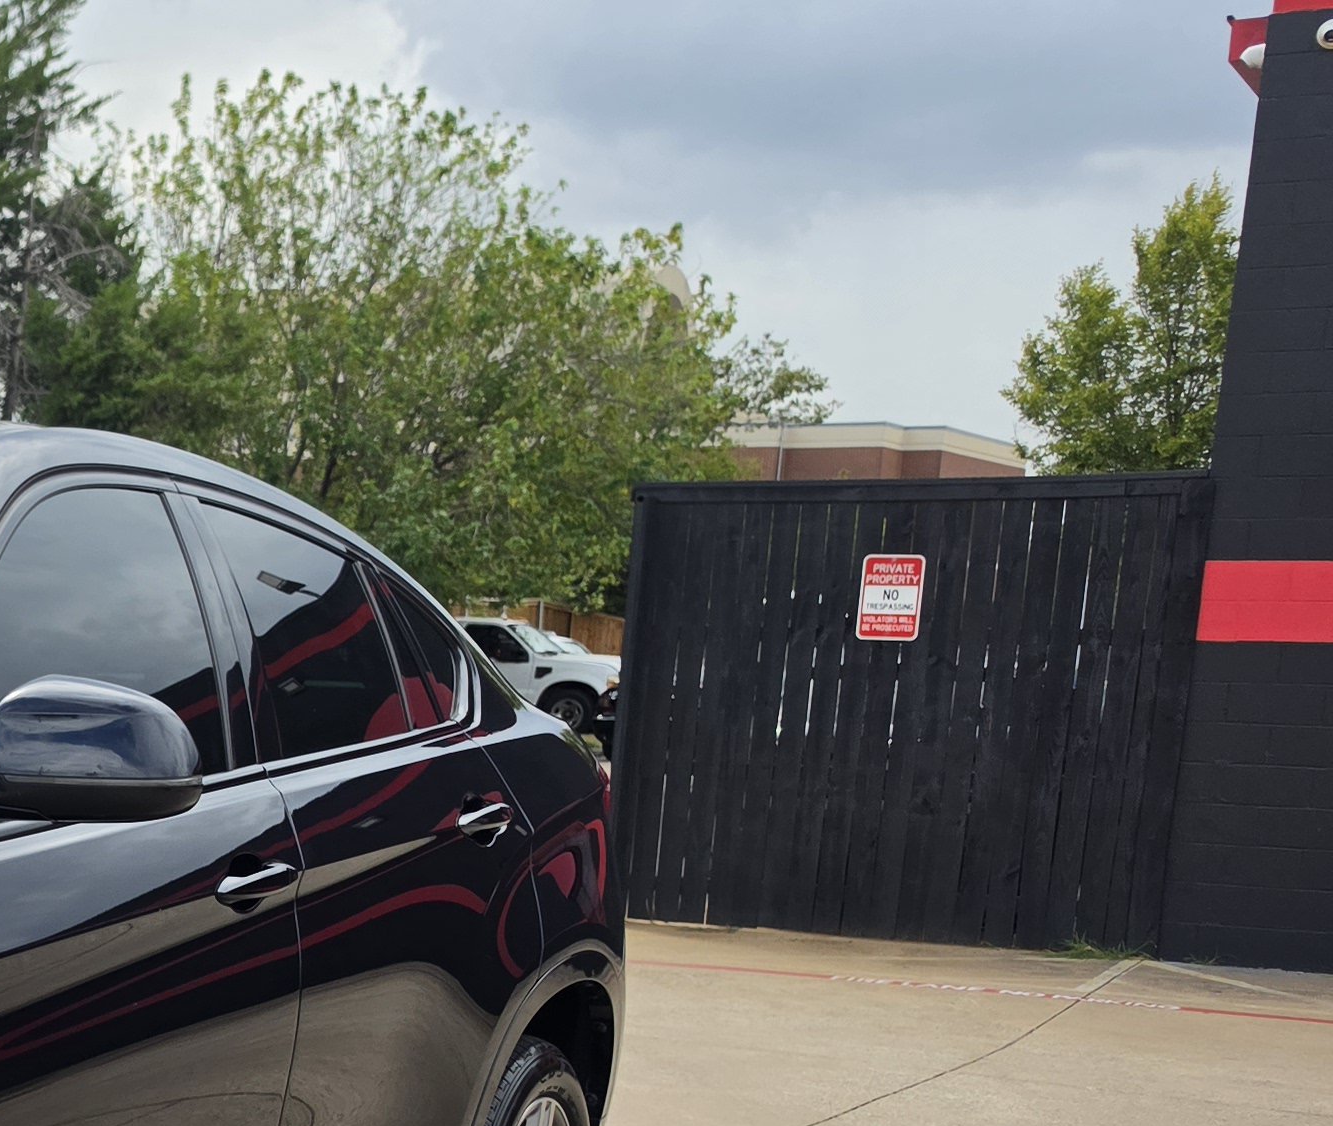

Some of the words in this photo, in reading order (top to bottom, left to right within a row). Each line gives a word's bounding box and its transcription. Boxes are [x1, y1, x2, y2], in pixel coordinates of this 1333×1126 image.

[872, 562, 916, 574] PRIVATE
[865, 574, 920, 585] PROPERTY
[882, 589, 899, 601] NO
[866, 602, 914, 611] TRESPASSING
